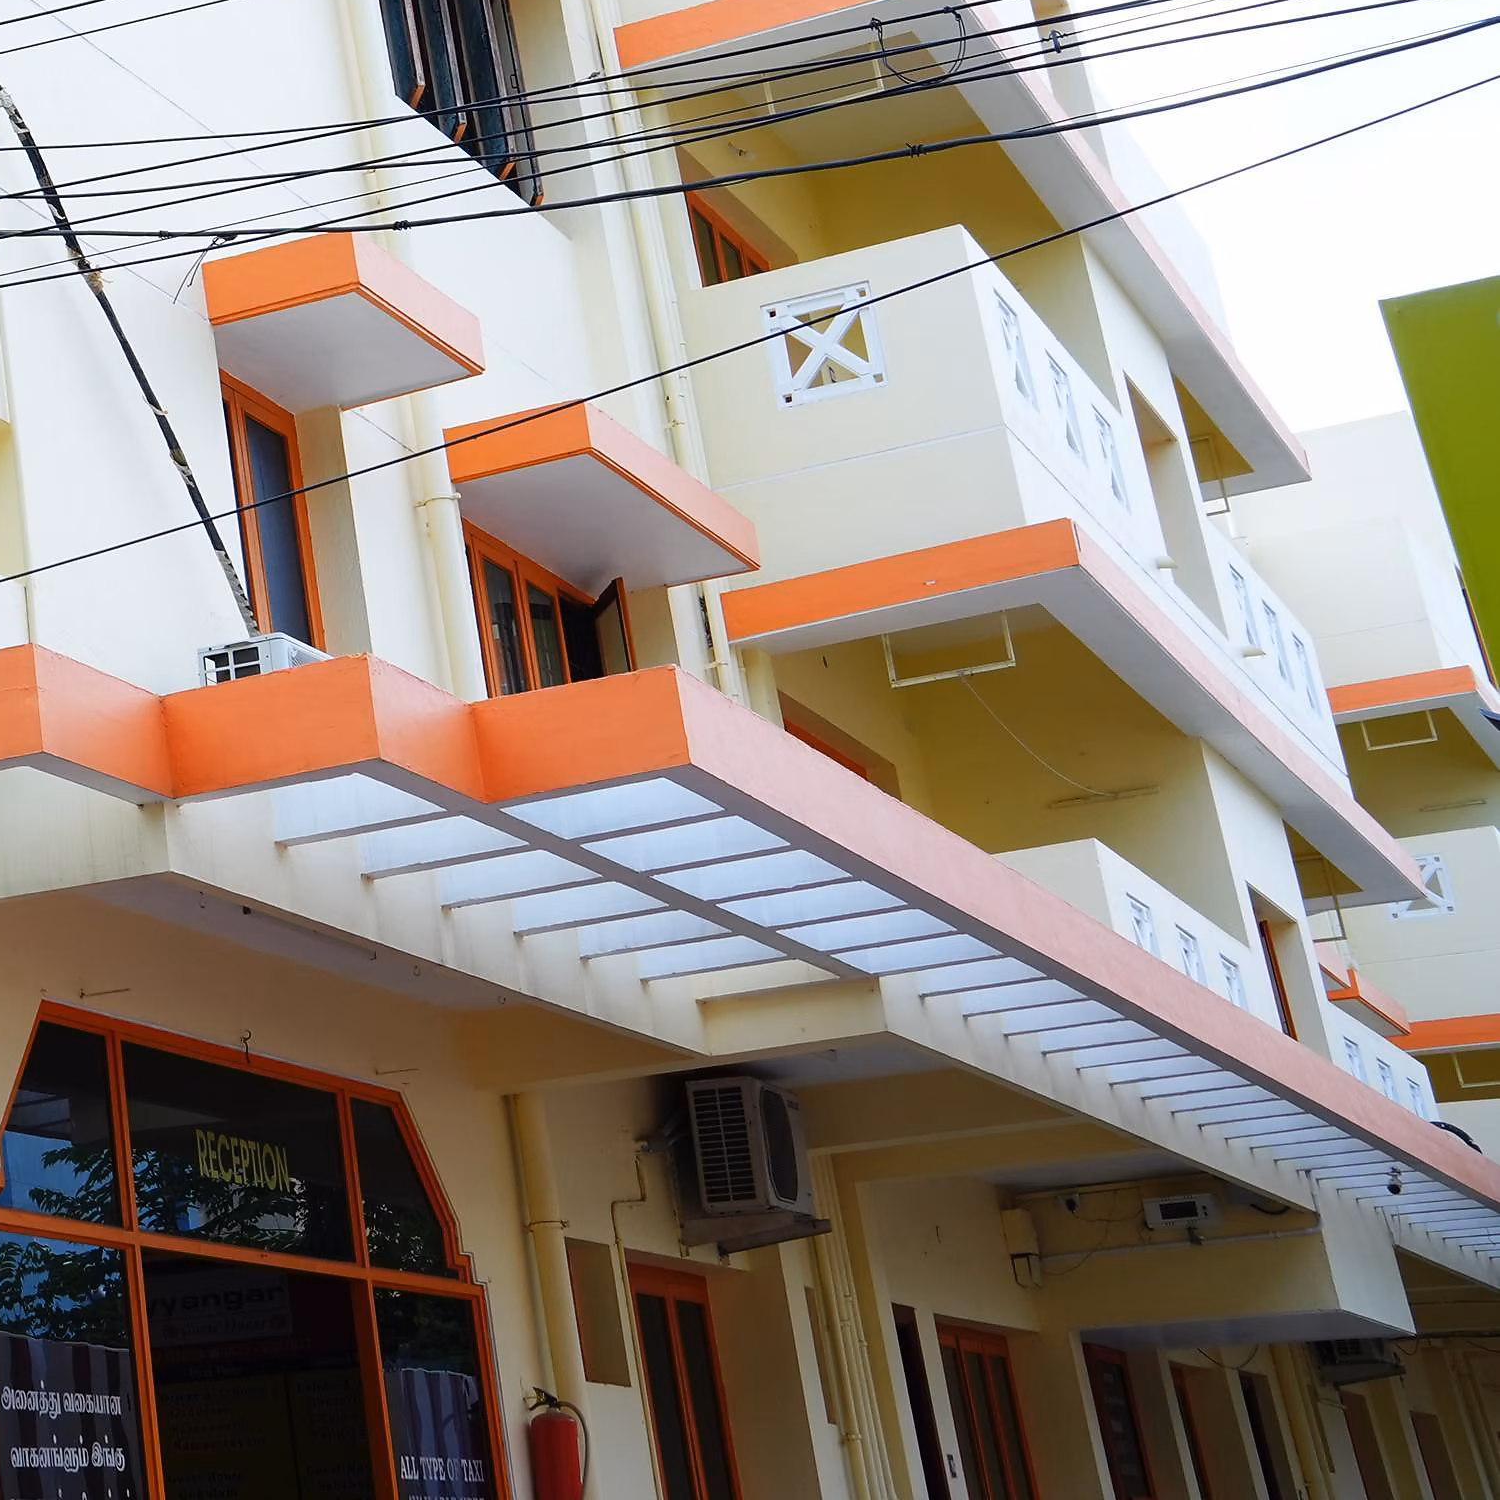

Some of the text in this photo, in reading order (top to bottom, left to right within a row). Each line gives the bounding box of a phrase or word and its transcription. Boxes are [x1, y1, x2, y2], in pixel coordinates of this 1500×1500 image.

[194, 1127, 291, 1194] RECEPTION
[1, 1380, 122, 1419] அனைத்து வகையான
[91, 1434, 126, 1472] இங்கு
[401, 1455, 419, 1480] ALL
[420, 1456, 446, 1481] TYPE
[461, 1458, 485, 1483] TAXI
